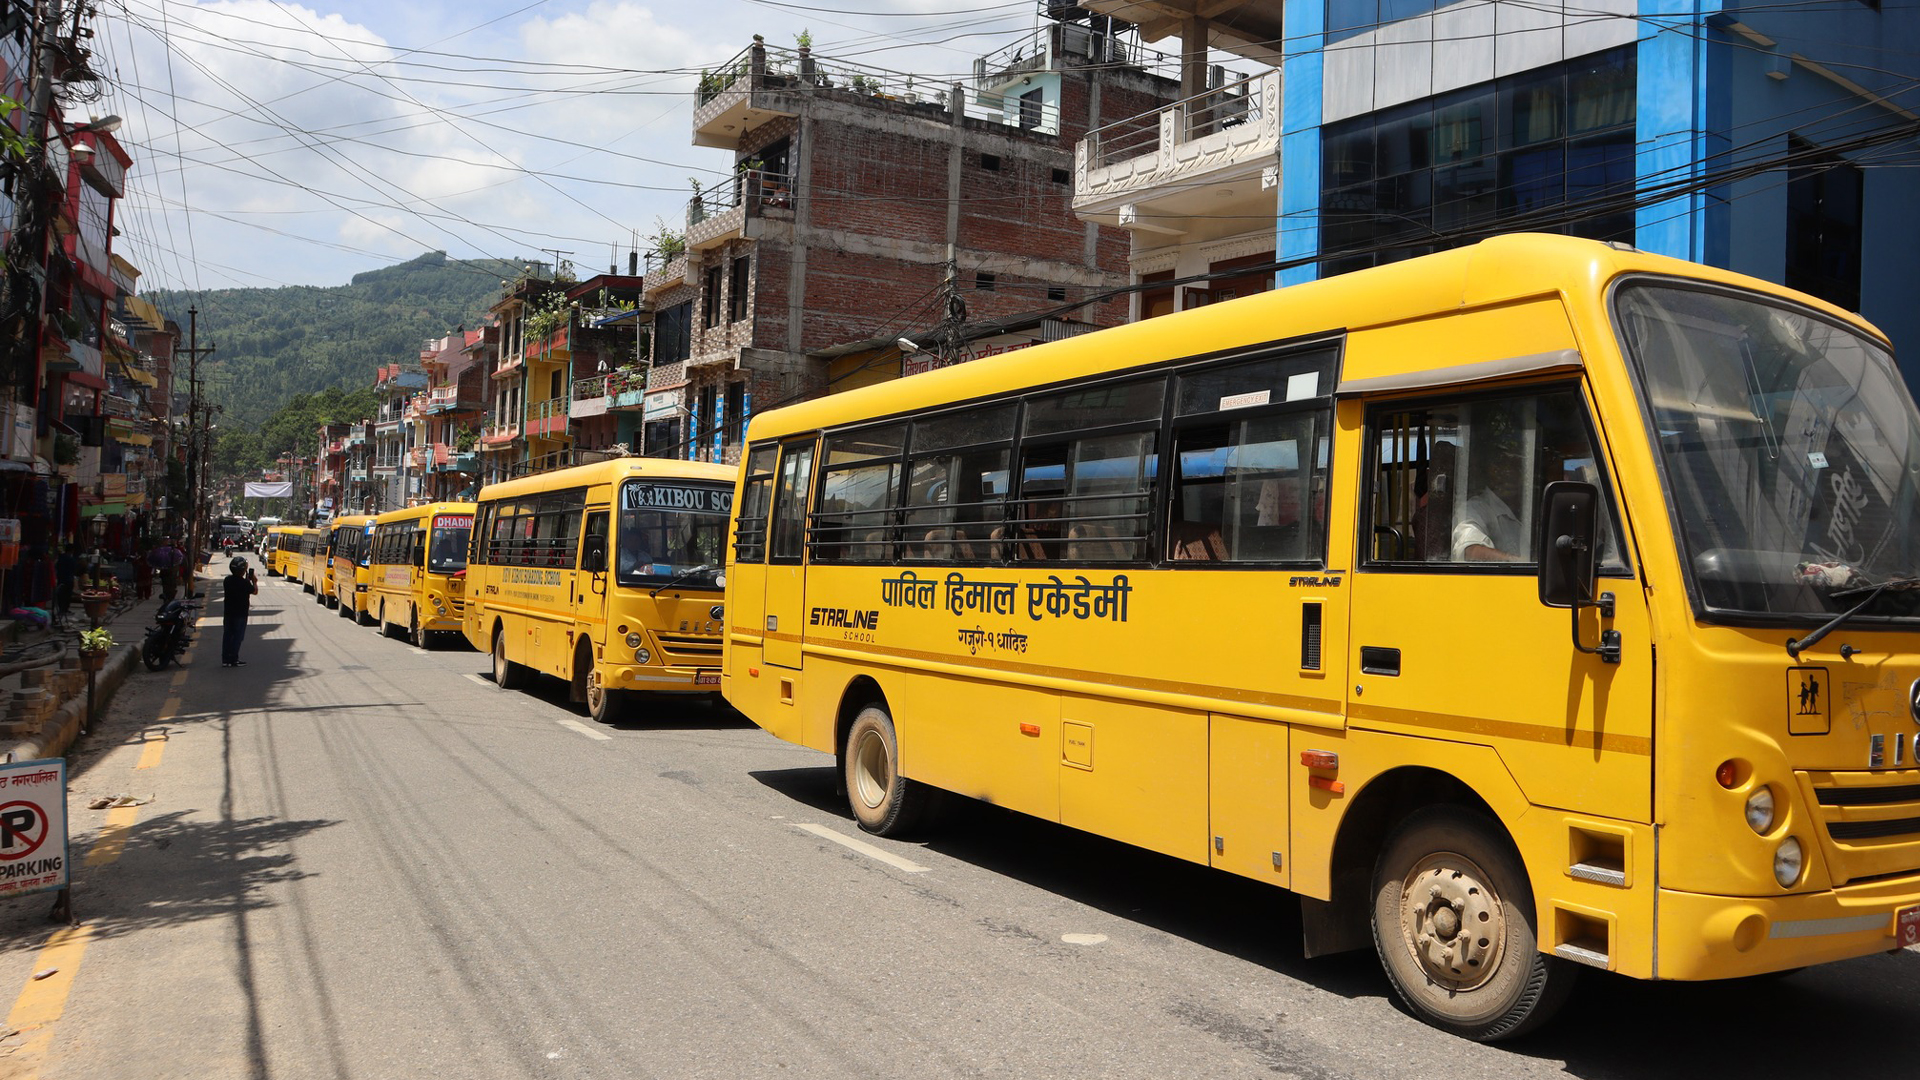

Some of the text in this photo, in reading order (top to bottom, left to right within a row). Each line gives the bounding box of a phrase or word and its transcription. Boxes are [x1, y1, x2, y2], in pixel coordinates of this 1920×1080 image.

[1222, 395, 1254, 407] EMERGENCY
[653, 487, 705, 509] KIBOU
[1289, 576, 1341, 587] STARLINE
[881, 570, 1133, 622] पाविल हिमाल एकेडेमी
[810, 607, 879, 631] STARLINE
[844, 631, 875, 643] SCHOOL
[11, 769, 58, 787] नगरपालिका
[0, 856, 62, 879] PARKING
